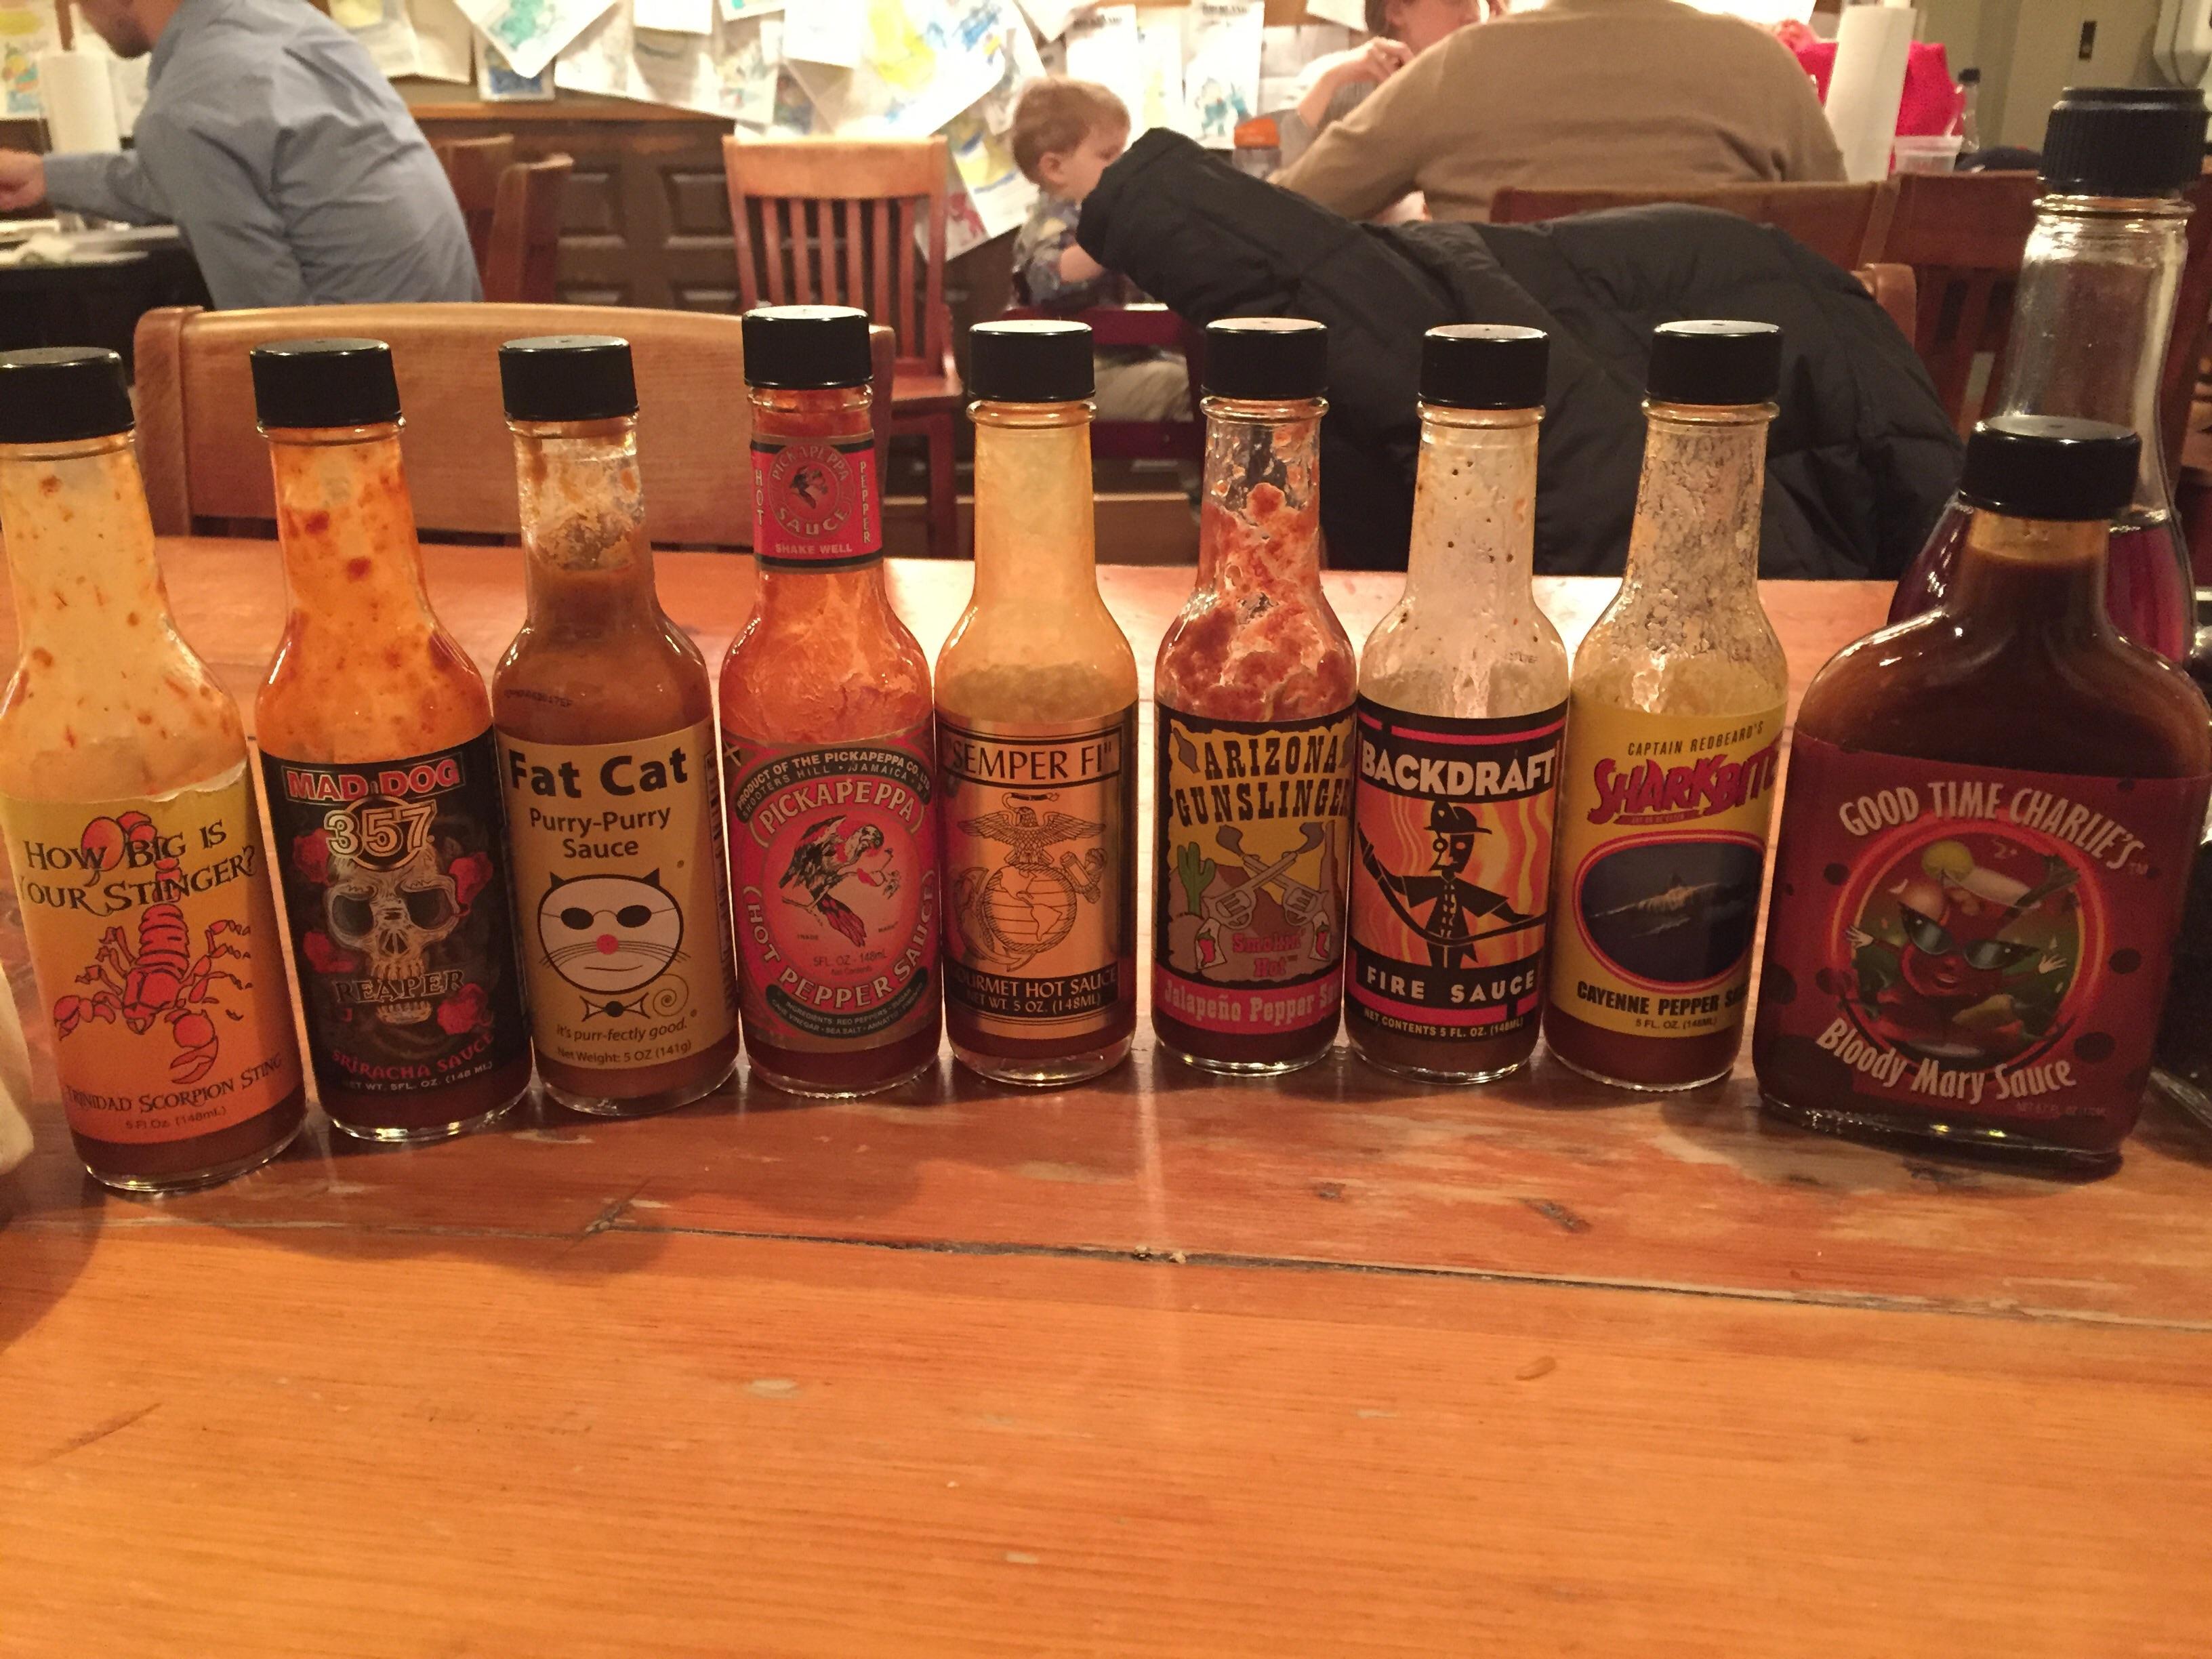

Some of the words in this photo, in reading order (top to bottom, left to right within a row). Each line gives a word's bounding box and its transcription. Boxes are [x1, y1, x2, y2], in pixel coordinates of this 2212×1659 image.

[779, 507, 847, 535] SAUCE
[775, 544, 816, 554] SHAKE
[819, 544, 853, 554] WELL
[1204, 735, 1339, 781] ARIZONA
[1627, 739, 1683, 757] CAPTAIN
[1689, 720, 1765, 753] REDBEARD'S
[287, 771, 369, 801] MAD
[378, 758, 461, 796] DOG
[508, 749, 582, 798] Fat
[599, 746, 689, 796] Cat
[737, 769, 771, 811] PRODUCT
[773, 762, 789, 775] OF
[792, 754, 821, 769] THE
[825, 751, 905, 769] PICKAPEPPA
[1361, 739, 1556, 796] BACKDRAFT
[743, 775, 791, 819] SHOOTERS
[796, 764, 832, 779] HILL
[758, 779, 916, 834] PICKAPEPPA
[323, 799, 438, 858] 357
[529, 806, 672, 839] Purry-Purry
[1839, 786, 1919, 837] GOOD
[1927, 781, 2004, 820] TIME
[2009, 787, 2147, 871] CHARLIE'S
[23, 840, 107, 871] HOW
[127, 832, 186, 869] BIG
[202, 819, 227, 849] IS
[562, 838, 639, 859] Sauce
[104, 844, 256, 914] STINGER?
[747, 905, 782, 964] HOT
[779, 967, 894, 1010] PEPPER
[893, 884, 934, 984] SAUCE
[332, 969, 465, 1004] REAPER
[950, 965, 1021, 998] OURMET
[1025, 981, 1065, 998] HOT
[1070, 966, 1118, 996] SAUCE
[1366, 964, 1425, 1001] FIRE
[1450, 968, 1536, 1004] SAUCE
[1577, 980, 1650, 1015] CAYENNE
[1657, 994, 1721, 1017] PEPPER
[1013, 1000, 1021, 1012] 5
[1052, 993, 1101, 1015] (148ML)
[1249, 994, 1315, 1027] Pepper
[574, 1027, 646, 1043] purr-fectly
[649, 1017, 688, 1040] good.
[1381, 1016, 1437, 1037] CONTENTS
[1439, 1028, 1446, 1037] 5
[436, 1031, 494, 1073] SAUCE
[623, 1053, 630, 1062] 5
[634, 1050, 652, 1061] OZ
[655, 1039, 692, 1059] (141g)
[1816, 1017, 1908, 1088] Bloody
[1910, 1057, 1986, 1106] Mary
[1995, 1059, 2078, 1101] Sauce
[139, 1078, 234, 1113] SCORPION
[241, 1052, 283, 1090] STING
